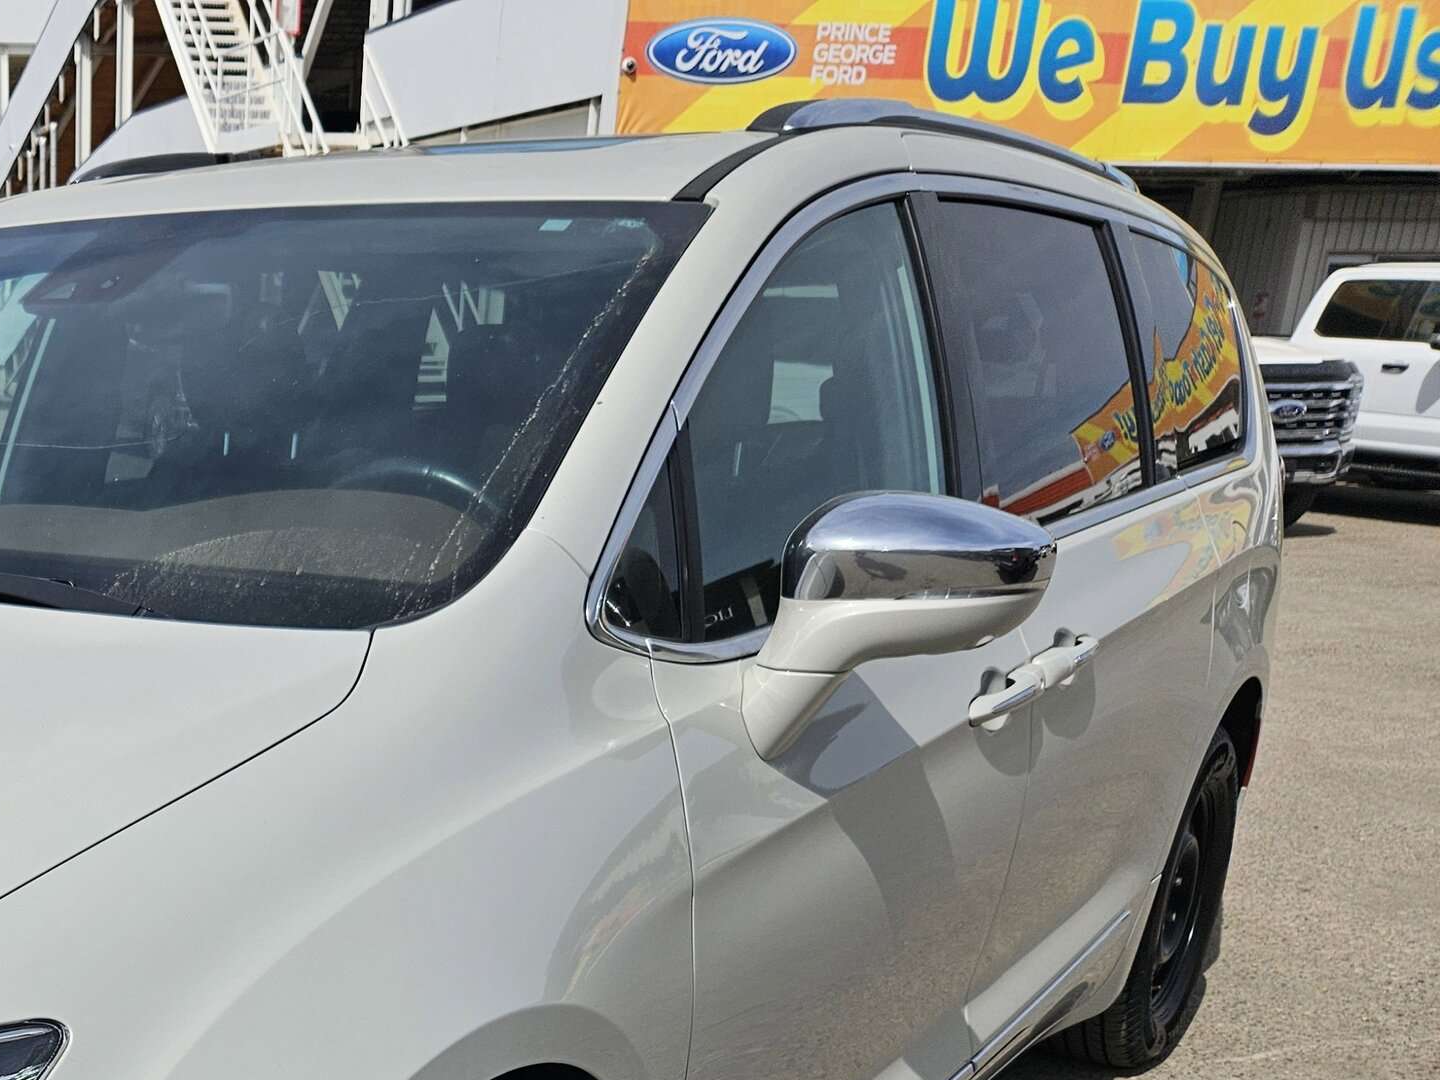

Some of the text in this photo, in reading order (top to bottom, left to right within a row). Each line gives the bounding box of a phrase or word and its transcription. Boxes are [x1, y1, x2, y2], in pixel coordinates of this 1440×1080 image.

[815, 21, 892, 44] PRINCE
[674, 26, 769, 74] Ford
[812, 43, 897, 65] GEORGE
[810, 65, 867, 86] FORD
[926, 0, 1440, 136] We Buy Us
